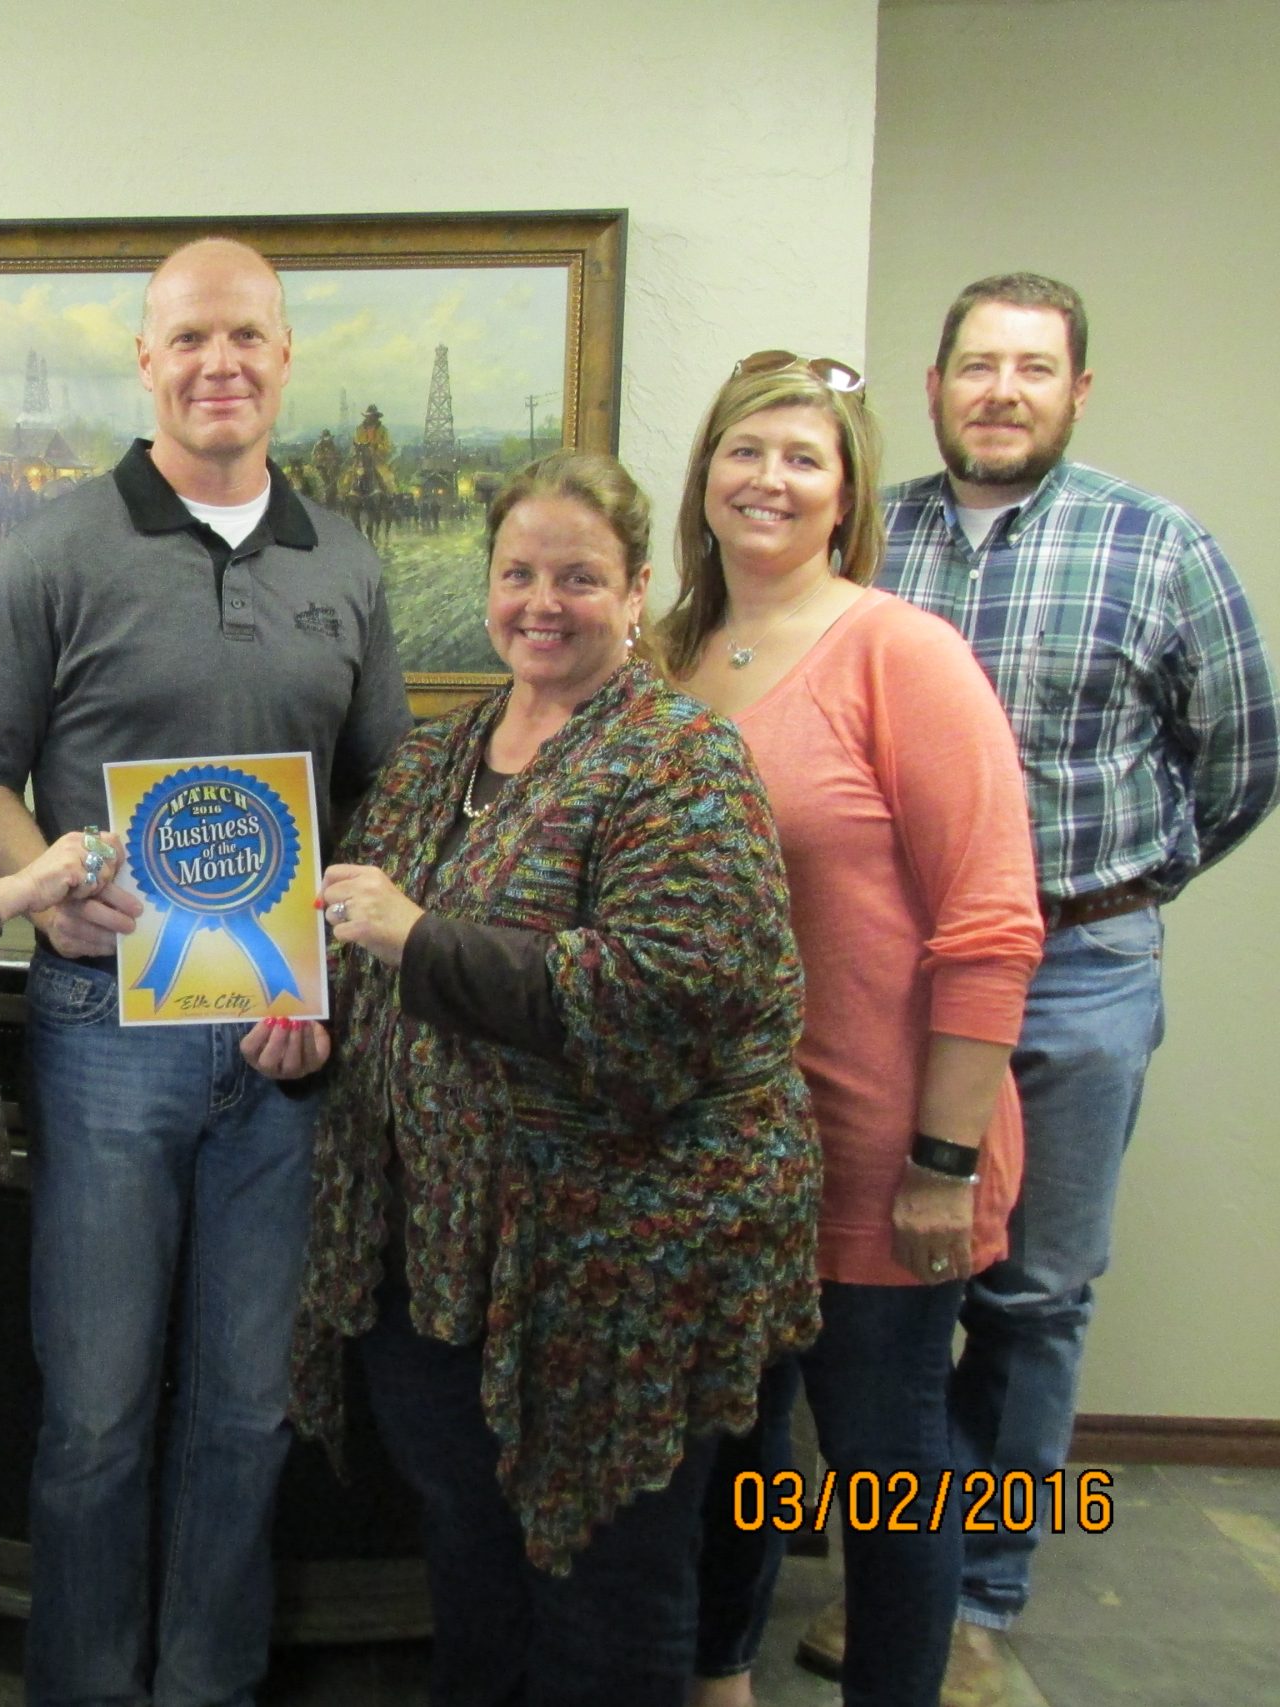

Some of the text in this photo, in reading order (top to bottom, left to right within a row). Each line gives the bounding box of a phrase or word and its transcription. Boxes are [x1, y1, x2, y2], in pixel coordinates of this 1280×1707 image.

[169, 786, 248, 815] MARCH
[192, 804, 222, 815] 2016
[158, 816, 260, 852] Business
[202, 841, 237, 860] of the
[178, 847, 262, 886] Month
[173, 991, 256, 1016] Elk City
